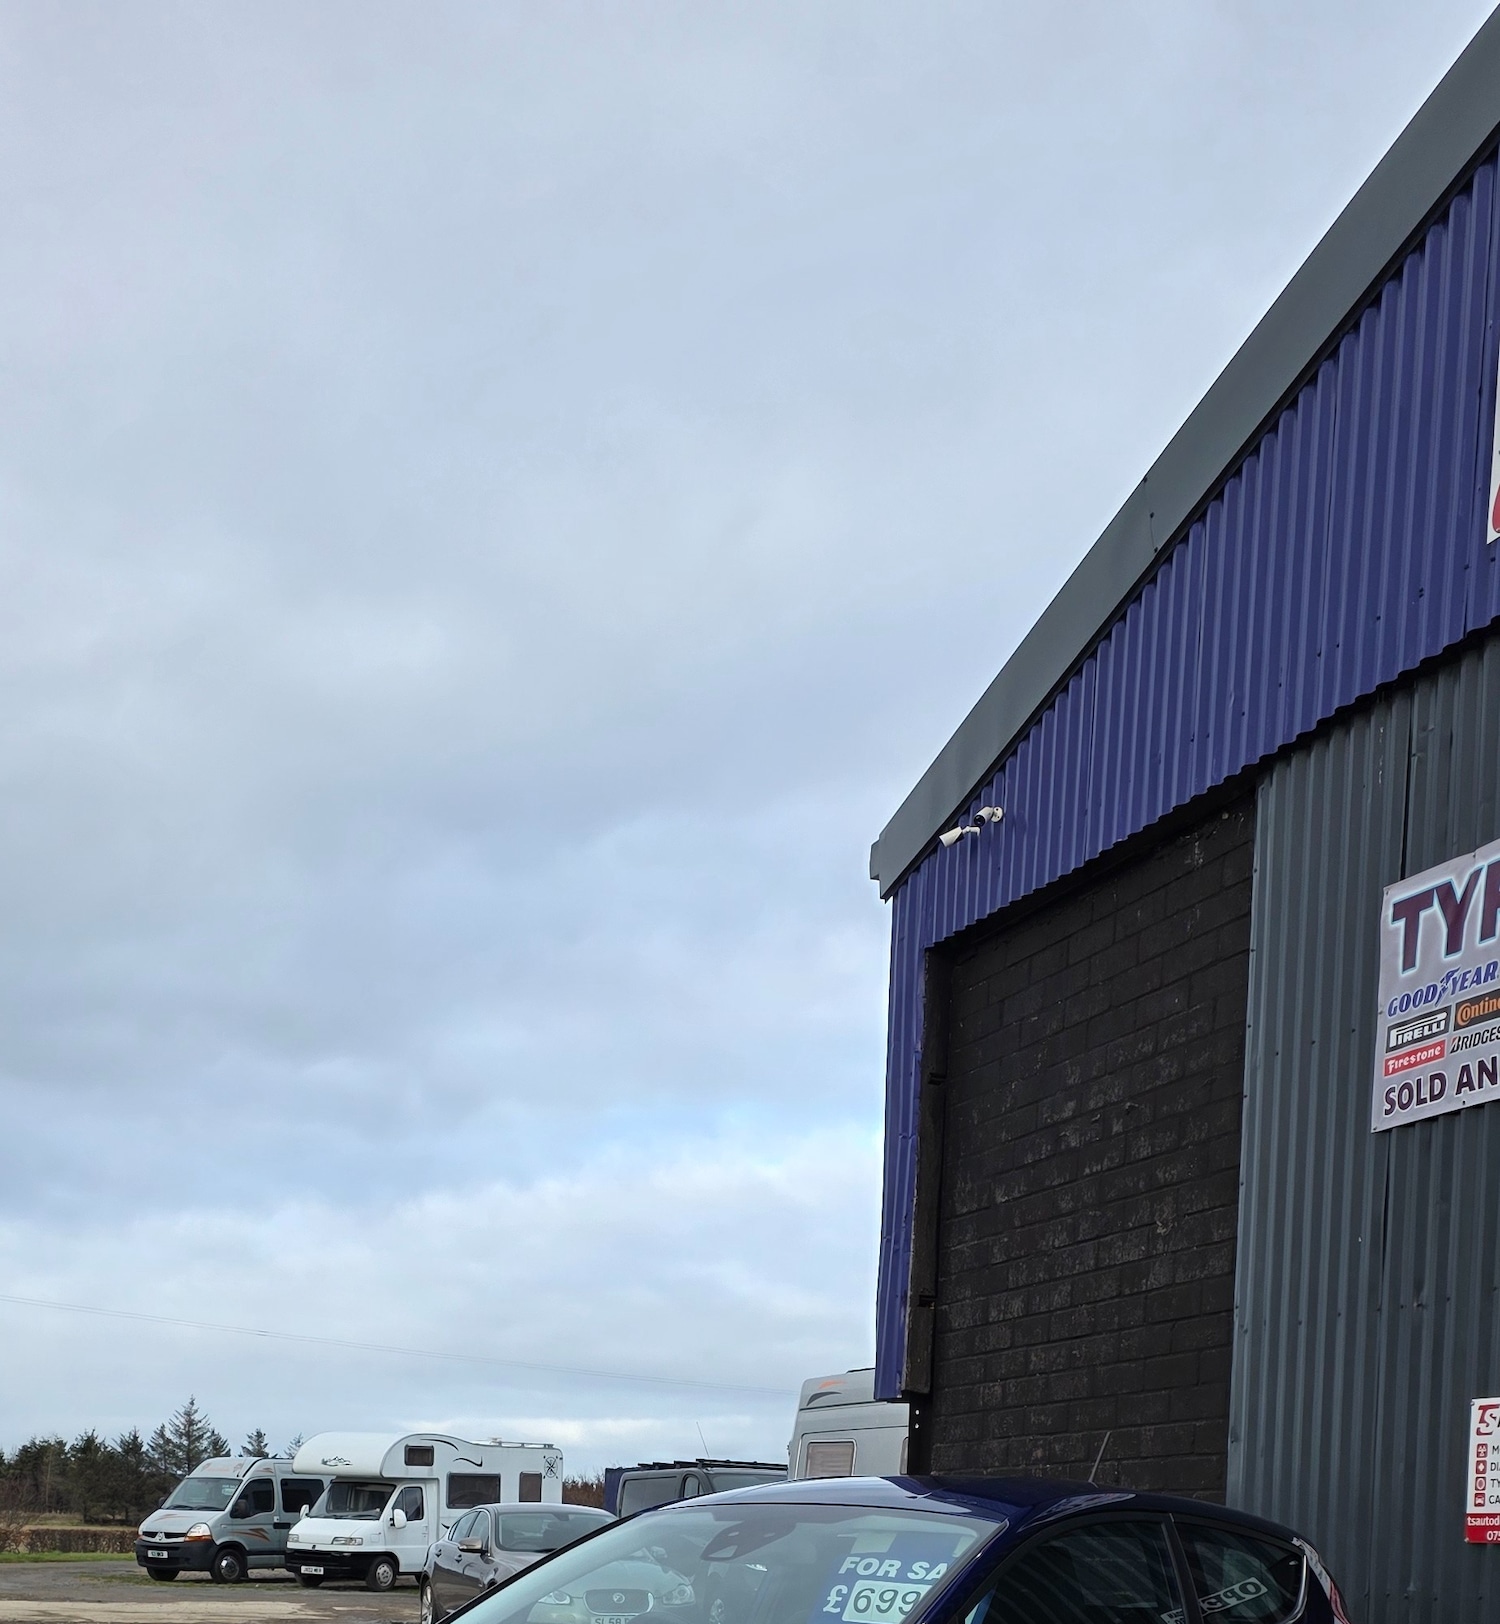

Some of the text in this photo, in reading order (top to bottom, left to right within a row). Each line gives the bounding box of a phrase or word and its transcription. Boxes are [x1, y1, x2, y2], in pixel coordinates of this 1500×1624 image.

[1387, 960, 1499, 1017] GOODYEAR
[1389, 1012, 1448, 1048] PIRELLI
[1387, 1045, 1442, 1074] Firestone
[1384, 1055, 1498, 1116] SOLD AN
[838, 1556, 902, 1578] FOR
